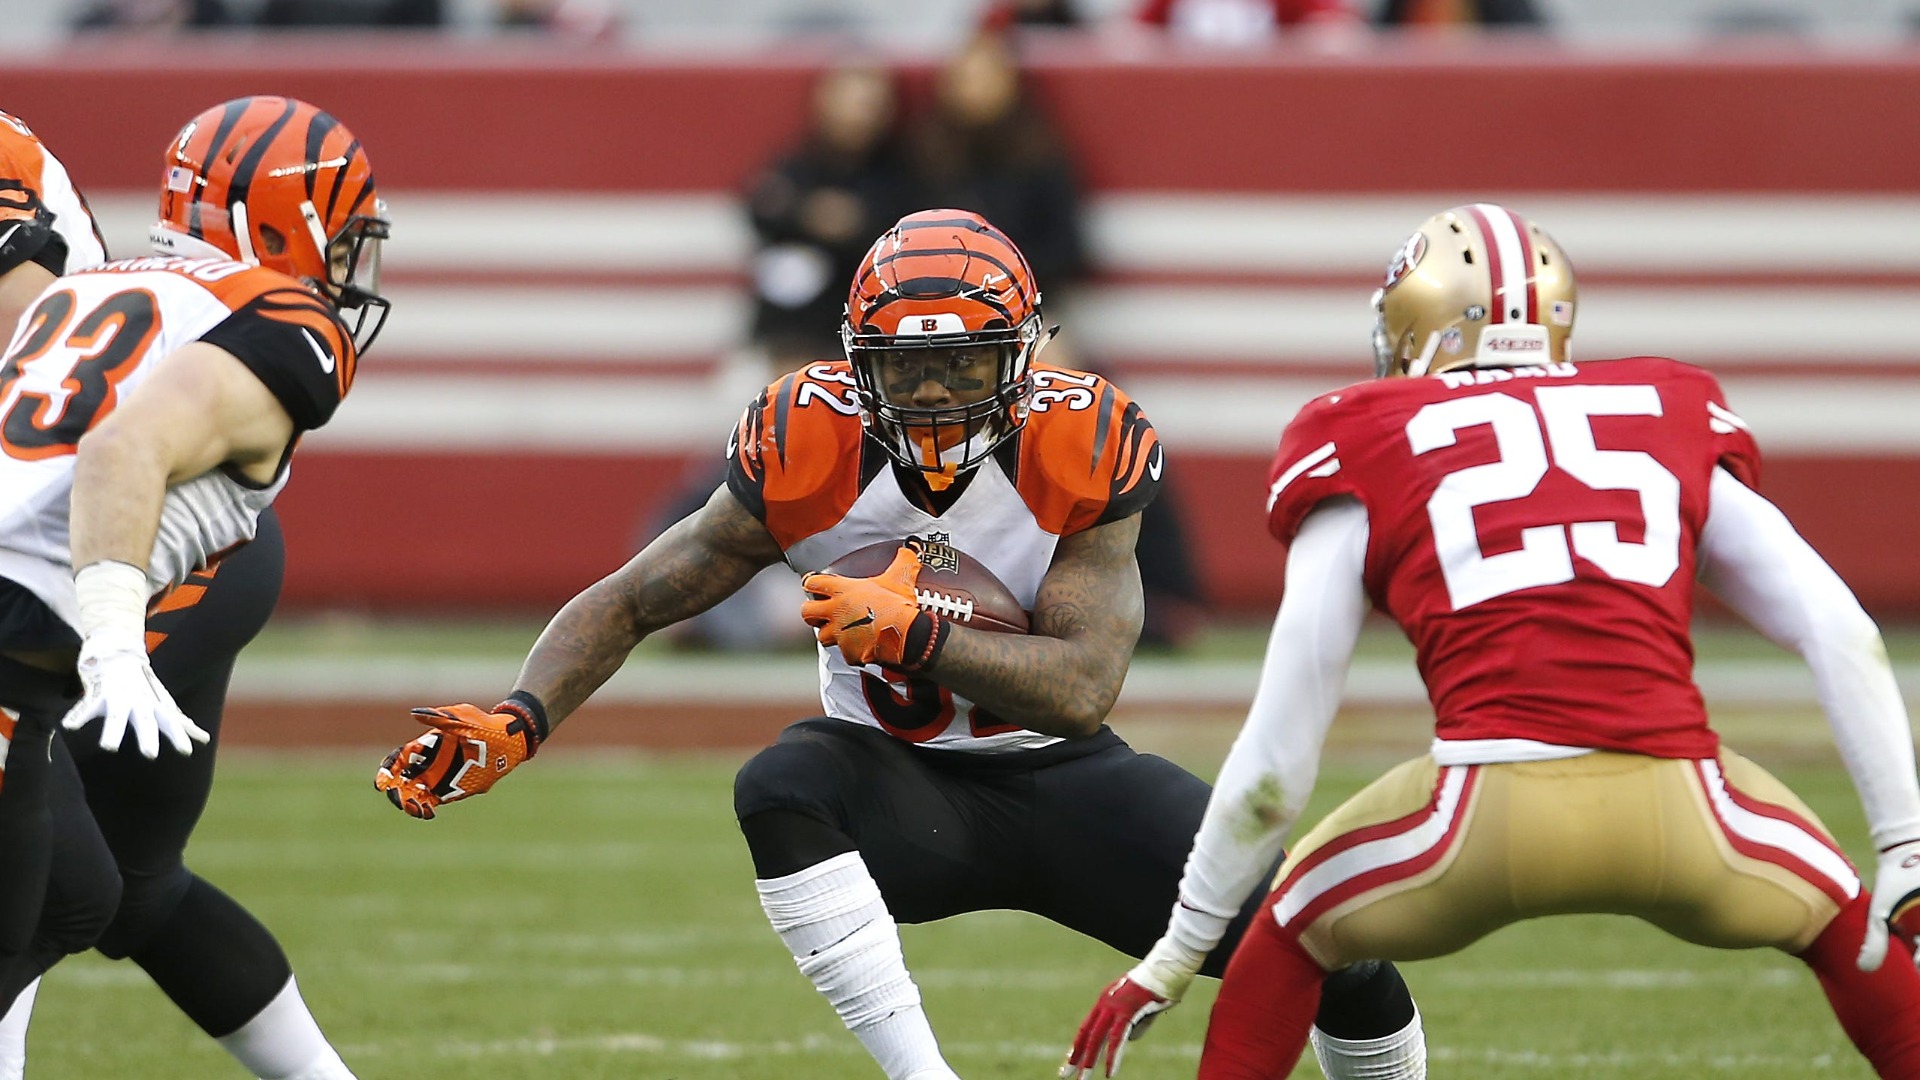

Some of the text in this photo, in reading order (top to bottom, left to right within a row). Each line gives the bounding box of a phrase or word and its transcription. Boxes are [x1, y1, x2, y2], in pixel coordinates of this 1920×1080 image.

[797, 365, 861, 415] 32
[1031, 370, 1097, 412] 32
[1405, 385, 1681, 611] 25
